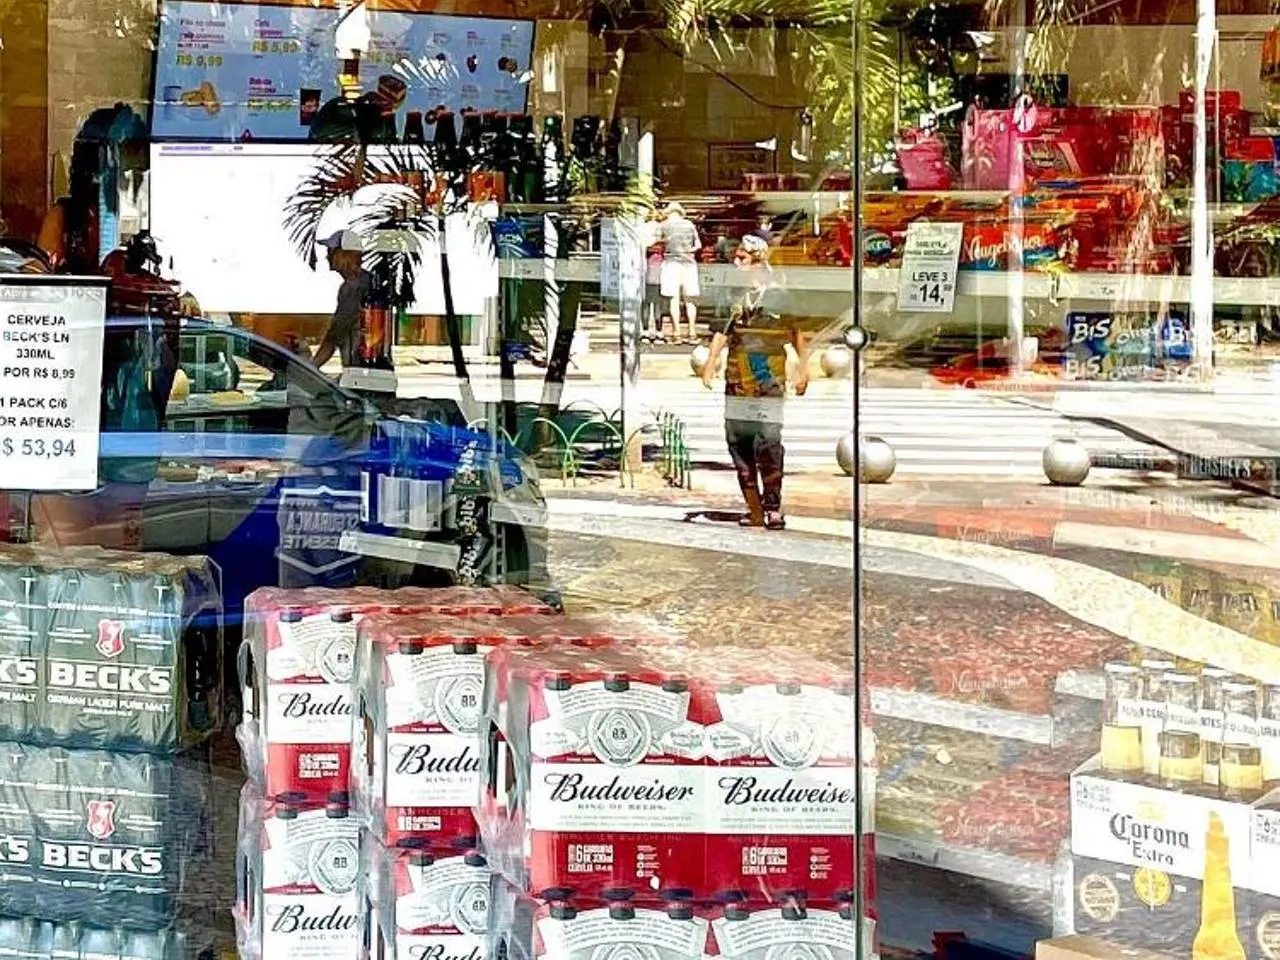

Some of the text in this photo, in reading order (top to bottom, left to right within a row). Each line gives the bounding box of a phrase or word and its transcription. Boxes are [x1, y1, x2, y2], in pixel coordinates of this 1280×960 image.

[961, 230, 1044, 267] Neugebuer
[912, 271, 948, 282] LEVE 3
[7, 314, 66, 326] CERVEJA
[3, 331, 70, 343] BECK'S LN
[16, 348, 56, 360] 330ML
[3, 367, 30, 378] POR
[33, 367, 49, 379] R$
[0, 396, 68, 409] 1 PACK C/6
[20, 416, 75, 428] APENAS:
[21, 438, 76, 459] 53,94
[48, 662, 171, 693] BECK'S
[543, 772, 694, 803] Budweiser
[718, 775, 856, 805] Budweise
[1109, 812, 1190, 849] Corona
[41, 842, 163, 874] BECK'S
[1131, 840, 1174, 866] Extra
